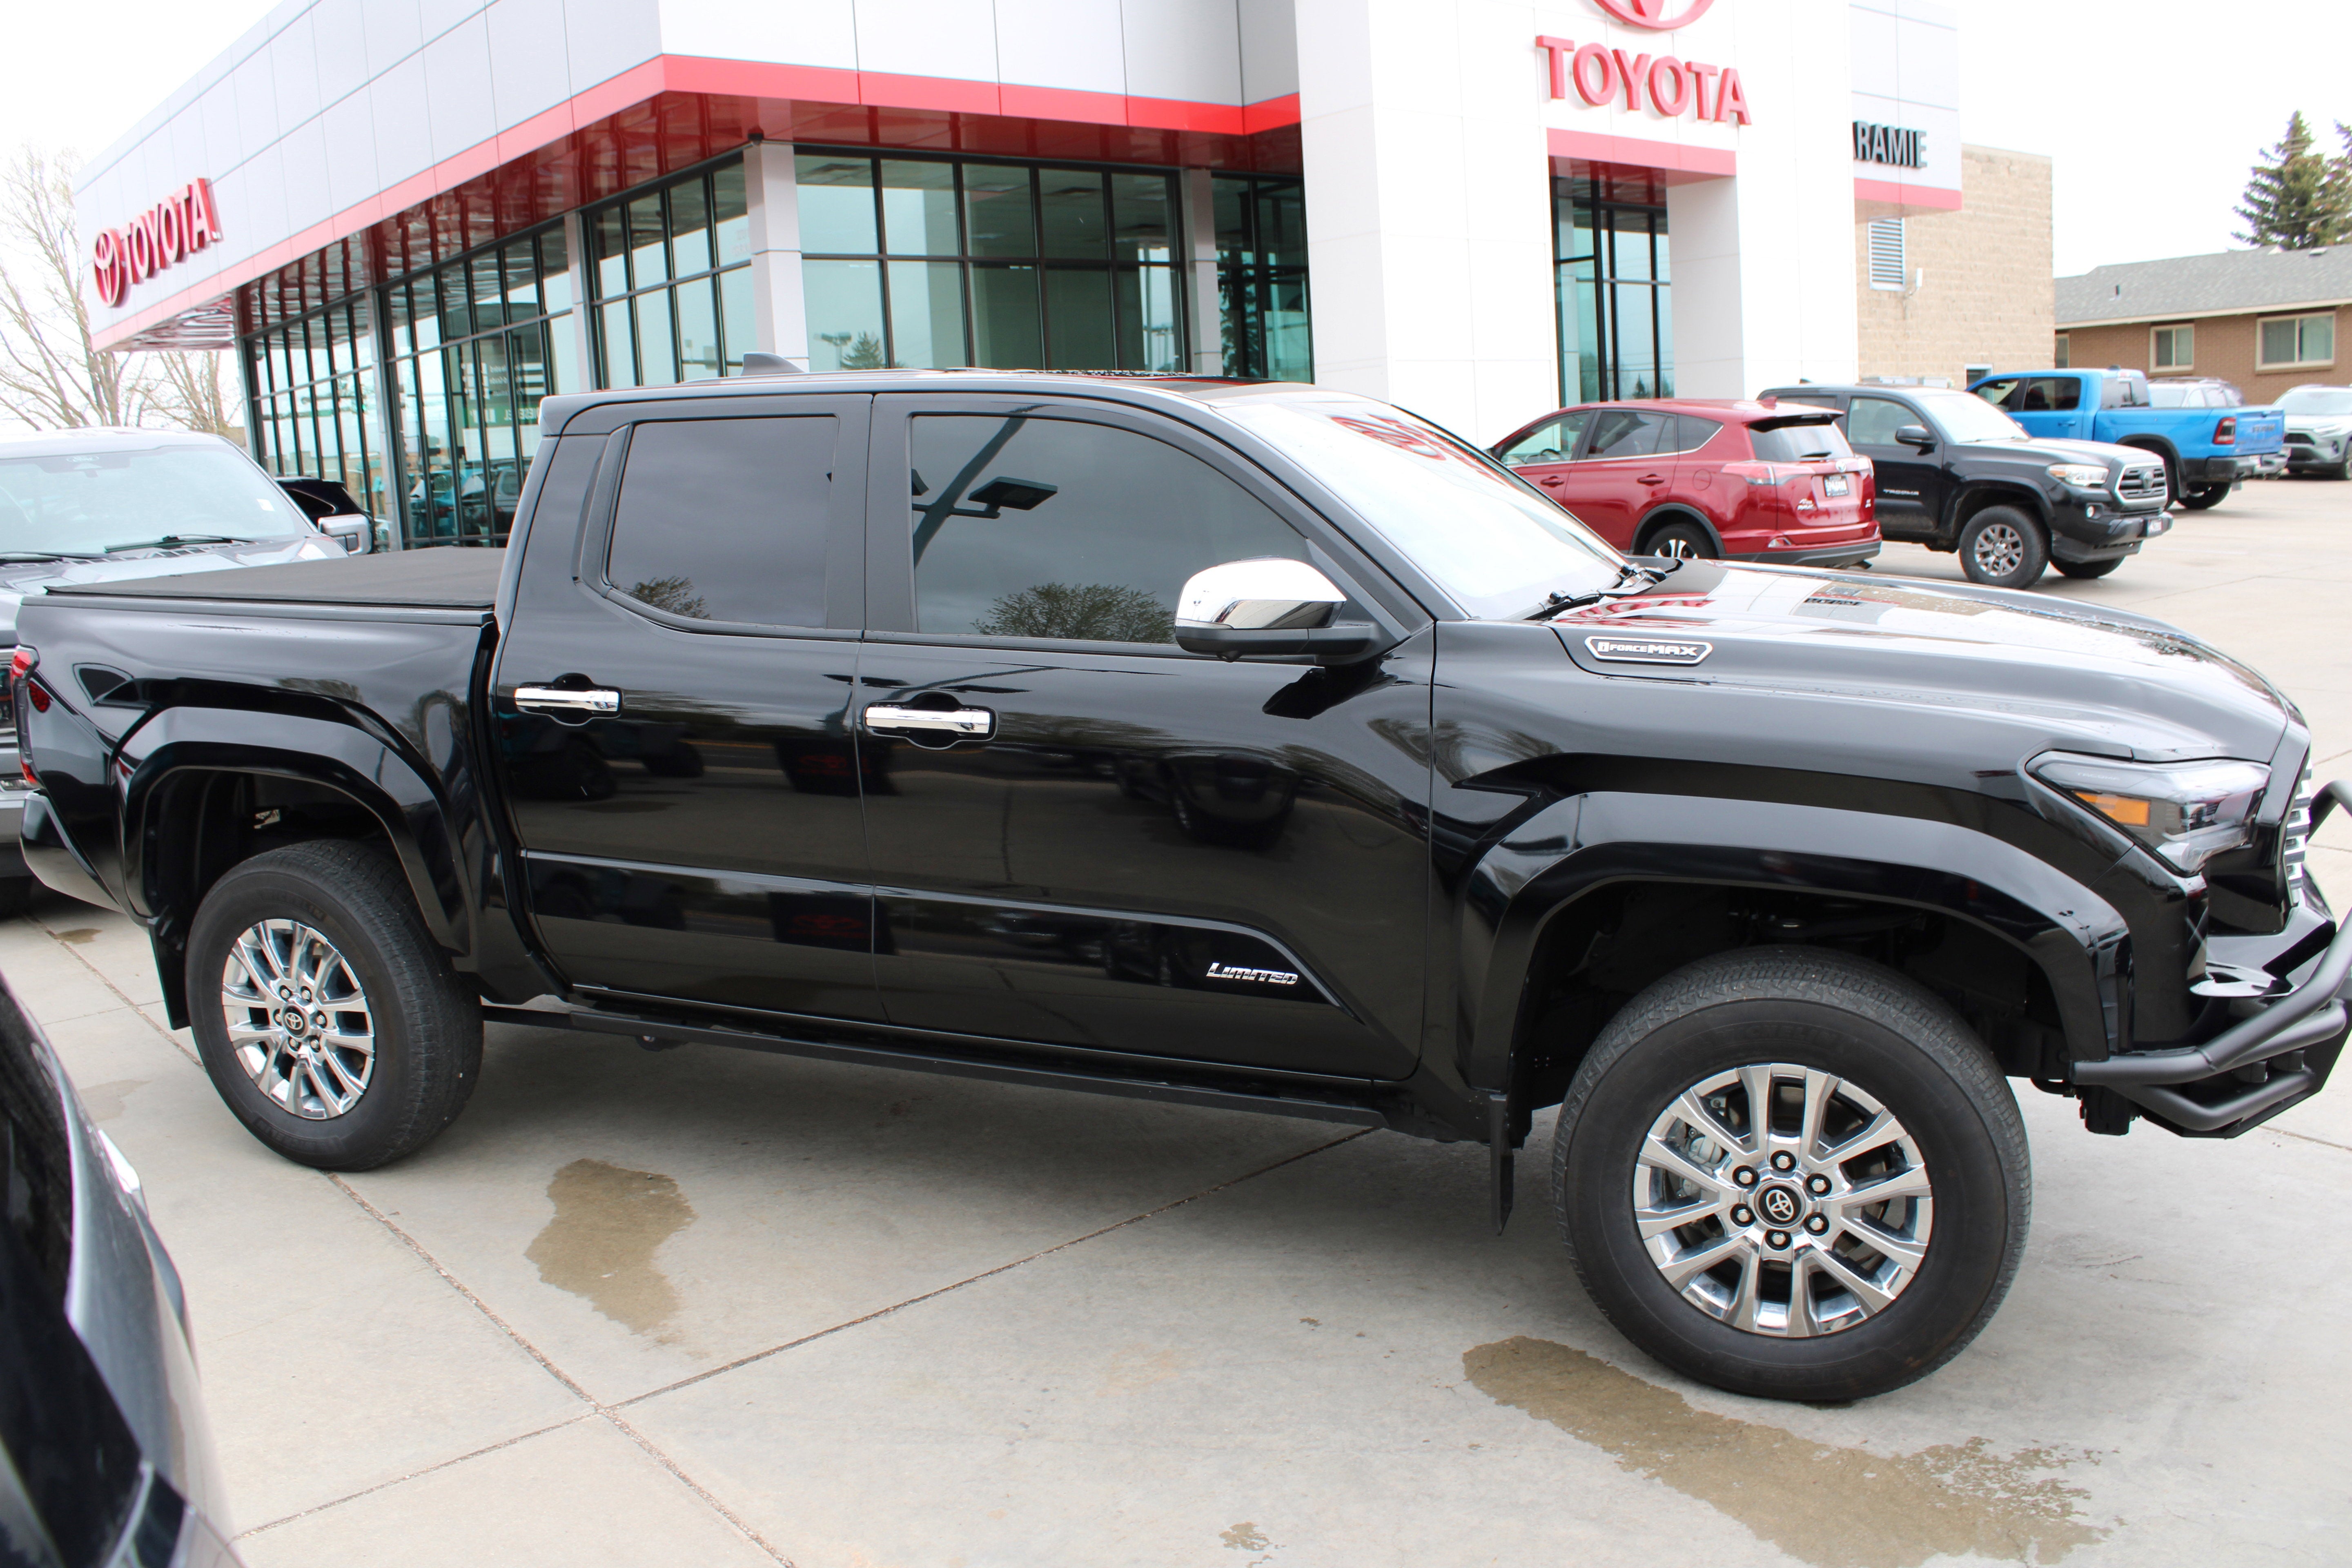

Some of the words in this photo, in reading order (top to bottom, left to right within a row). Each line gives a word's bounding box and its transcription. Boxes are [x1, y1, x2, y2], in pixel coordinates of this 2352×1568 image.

[1536, 35, 1752, 125] TOYOTA
[1853, 120, 1927, 168] RAMIE
[120, 178, 220, 285] TOYOTA
[1206, 962, 1298, 985] LIMITED
